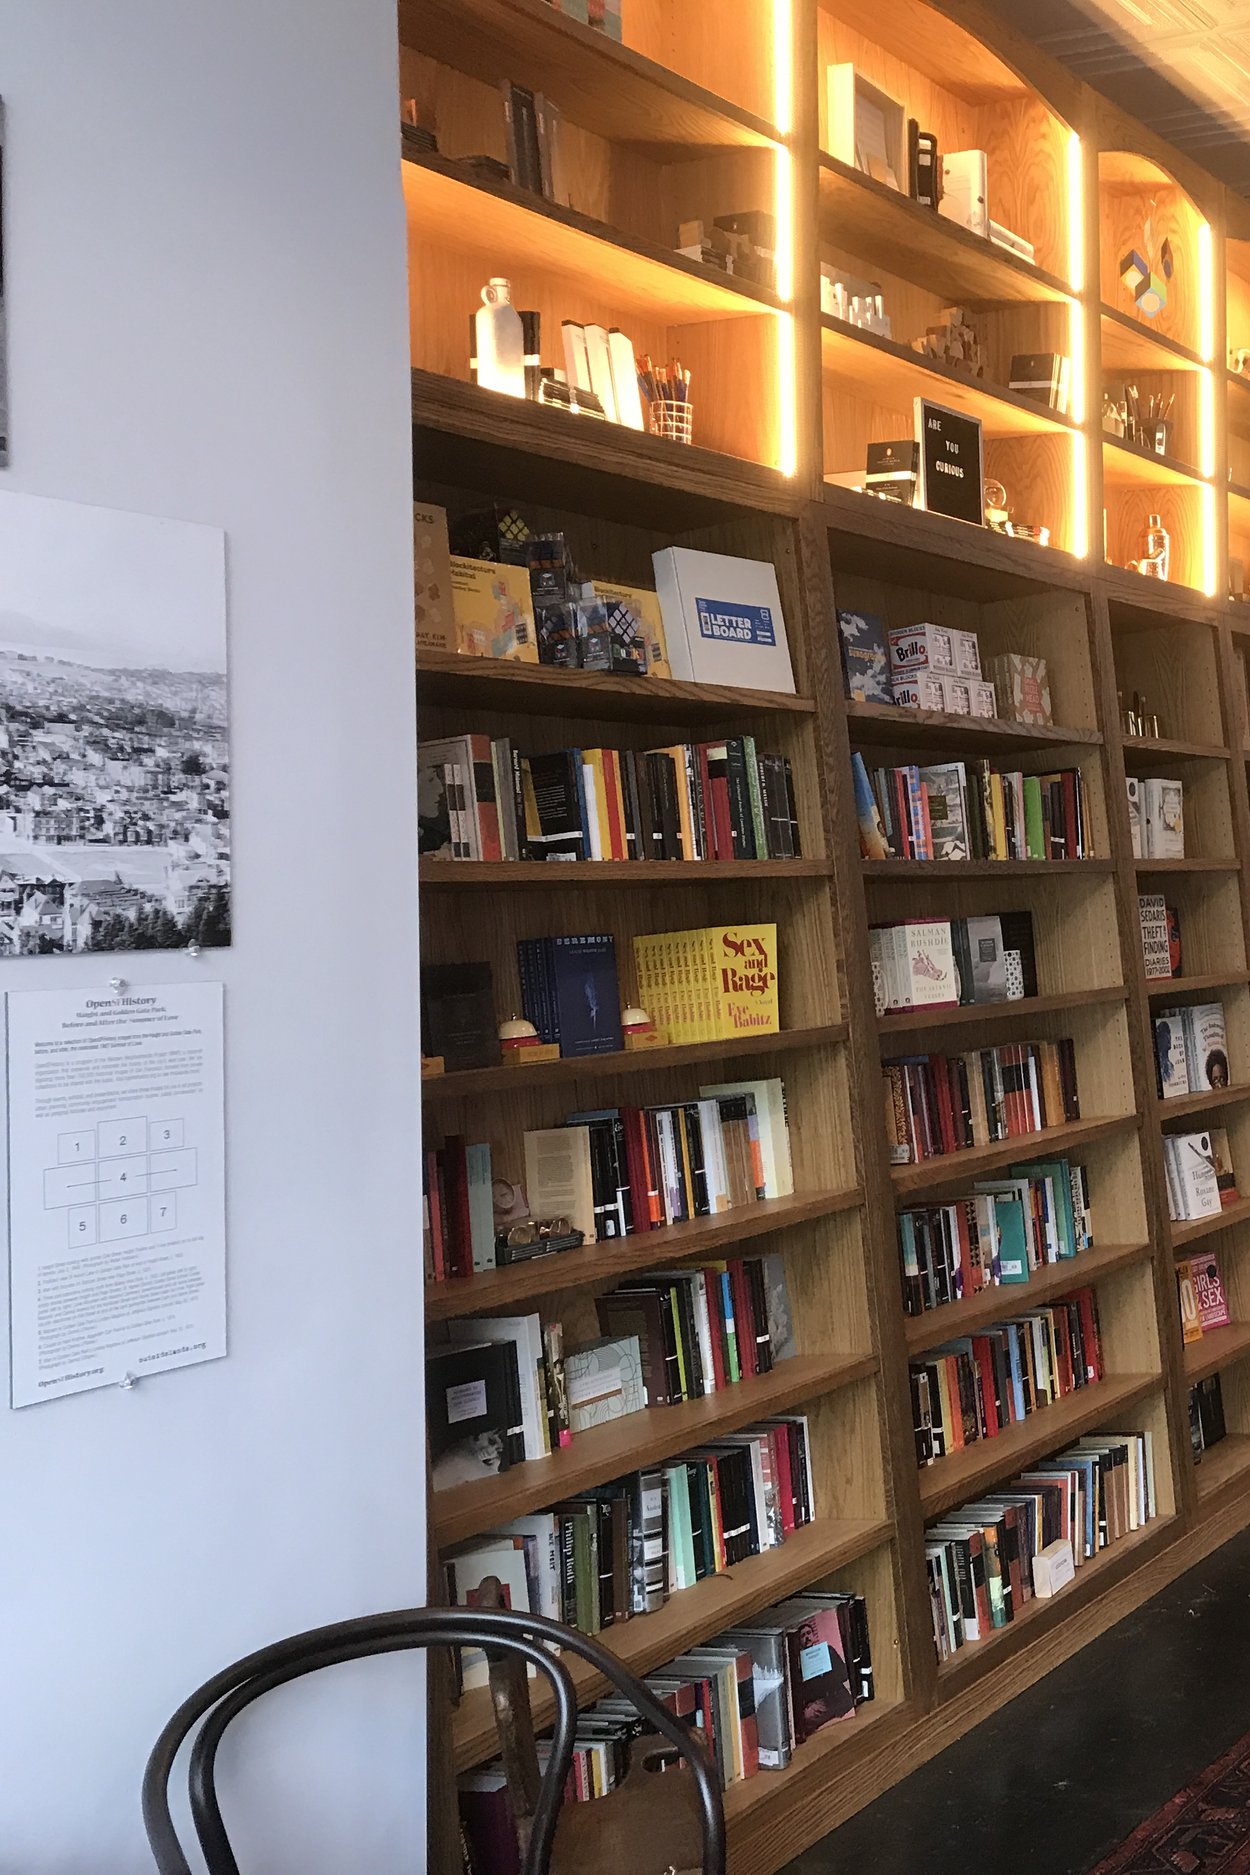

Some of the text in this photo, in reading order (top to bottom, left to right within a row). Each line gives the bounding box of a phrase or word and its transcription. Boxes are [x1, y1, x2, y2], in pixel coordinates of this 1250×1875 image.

[928, 418, 941, 431] ARE
[945, 440, 959, 454] YOU
[935, 460, 964, 478] CURIOUS
[711, 613, 751, 629] LETTER
[712, 625, 752, 639] BOARD
[896, 641, 926, 662] Brillo
[1139, 898, 1164, 909] DAVID
[1140, 909, 1166, 922] SEDARIS
[911, 928, 947, 937] SALMAN
[722, 932, 767, 958] Sex
[1143, 940, 1168, 955] FINDING
[744, 956, 768, 970] and
[1145, 957, 1169, 967] DIARIES
[721, 968, 776, 997] Rage
[727, 1002, 749, 1017] Eve
[733, 1013, 772, 1029] Babitz
[75, 1129, 171, 1151] 1 2 3
[120, 1172, 127, 1182] 4
[1201, 1197, 1213, 1208] Gay
[79, 1207, 167, 1232] 5 6 7
[1193, 1273, 1220, 1293] GIRLS
[1202, 1286, 1224, 1309] SEX
[564, 1521, 575, 1584] Philip Roth
